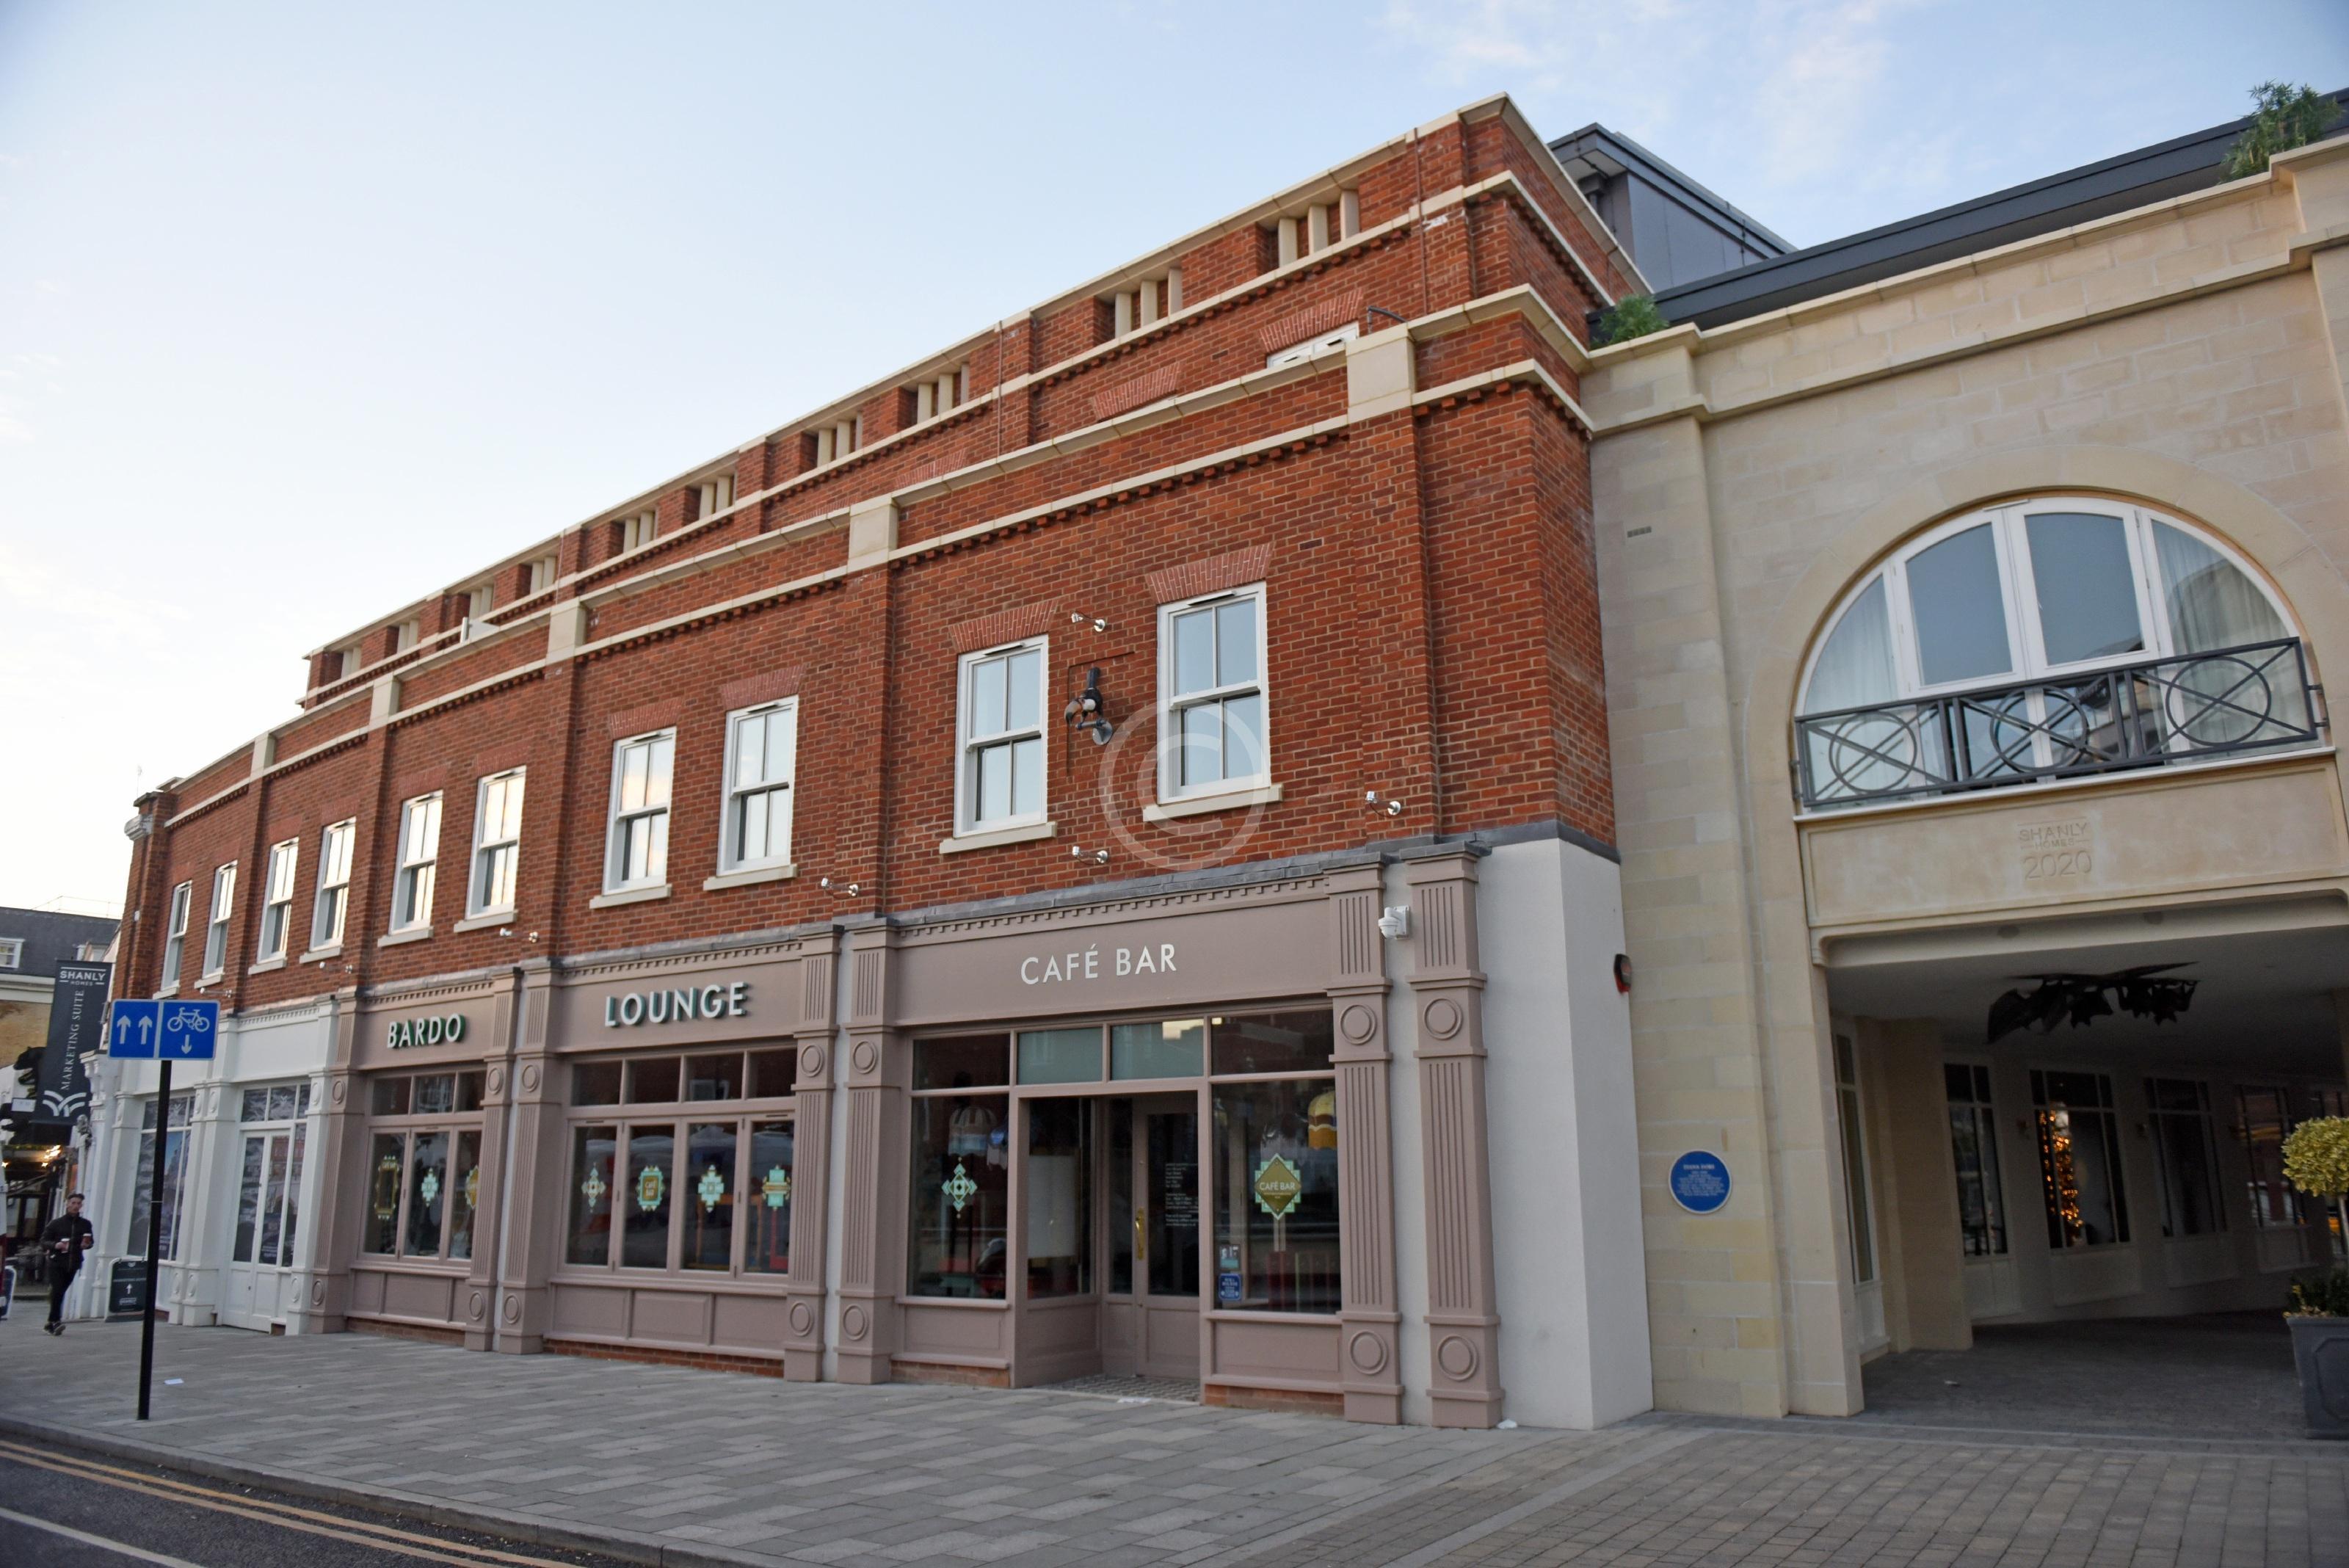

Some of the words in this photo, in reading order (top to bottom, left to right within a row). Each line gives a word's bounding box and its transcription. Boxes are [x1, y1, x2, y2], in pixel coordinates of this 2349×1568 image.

[2019, 822, 2088, 842] SHANLY
[2023, 851, 2092, 880] 2020
[59, 970, 106, 981] SHANLY
[1020, 943, 1099, 985] CAFÉ
[1116, 944, 1177, 976] BAR
[605, 981, 748, 1027] LOUNGE
[60, 1023, 80, 1091] MARKETING
[72, 990, 84, 1021] SUITE
[387, 1013, 464, 1048] BARDO
[1259, 1180, 1279, 1191] CAFÉ
[1279, 1182, 1296, 1190] BAR
